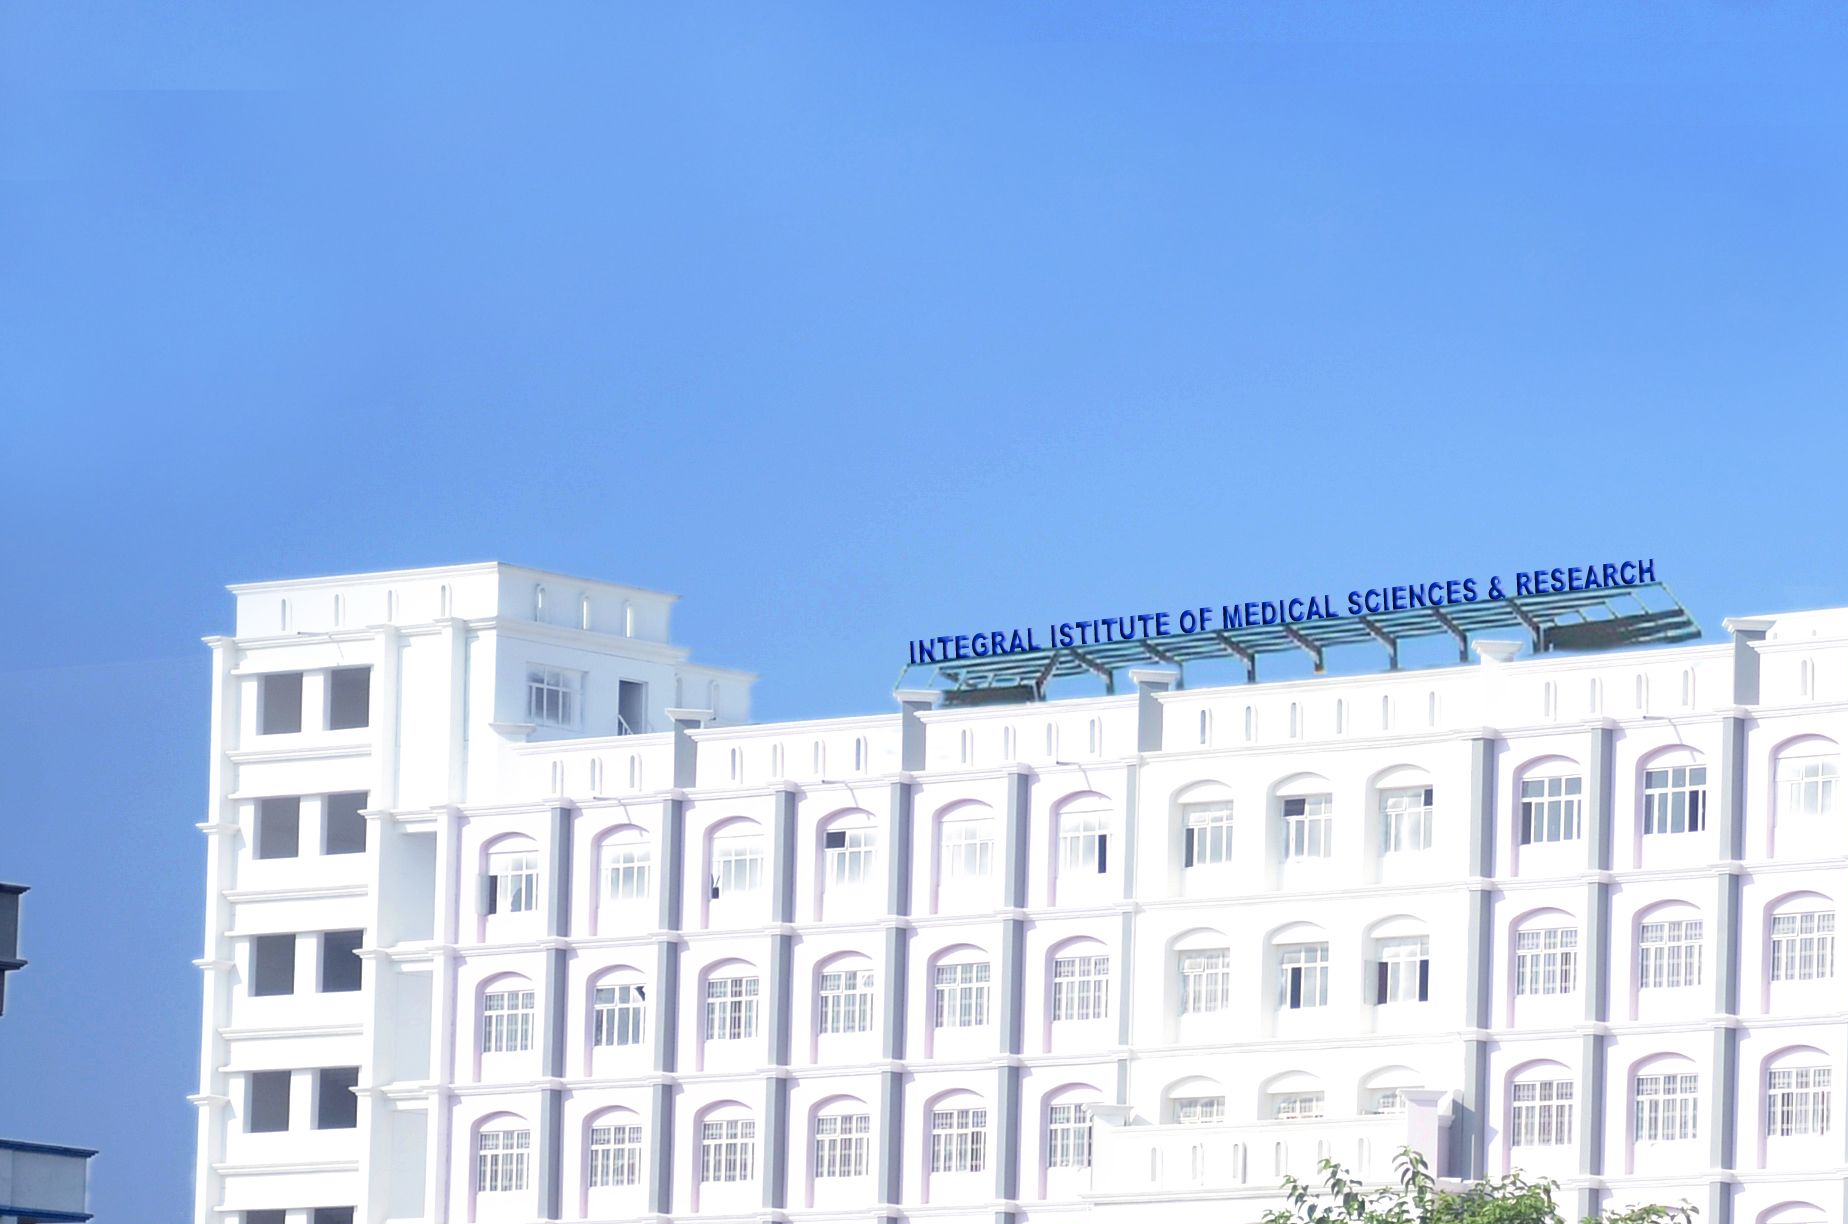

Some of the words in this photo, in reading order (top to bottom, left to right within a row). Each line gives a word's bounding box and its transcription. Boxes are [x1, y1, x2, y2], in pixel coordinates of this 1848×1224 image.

[909, 627, 1041, 664] INTEGRAL
[1050, 612, 1171, 648] ISTITUTE
[1179, 607, 1213, 634] OF
[1222, 594, 1339, 630] MEDICAL
[1348, 577, 1478, 615] SCIENCES
[1488, 575, 1506, 600] &
[1516, 558, 1656, 596] RESEARCH
